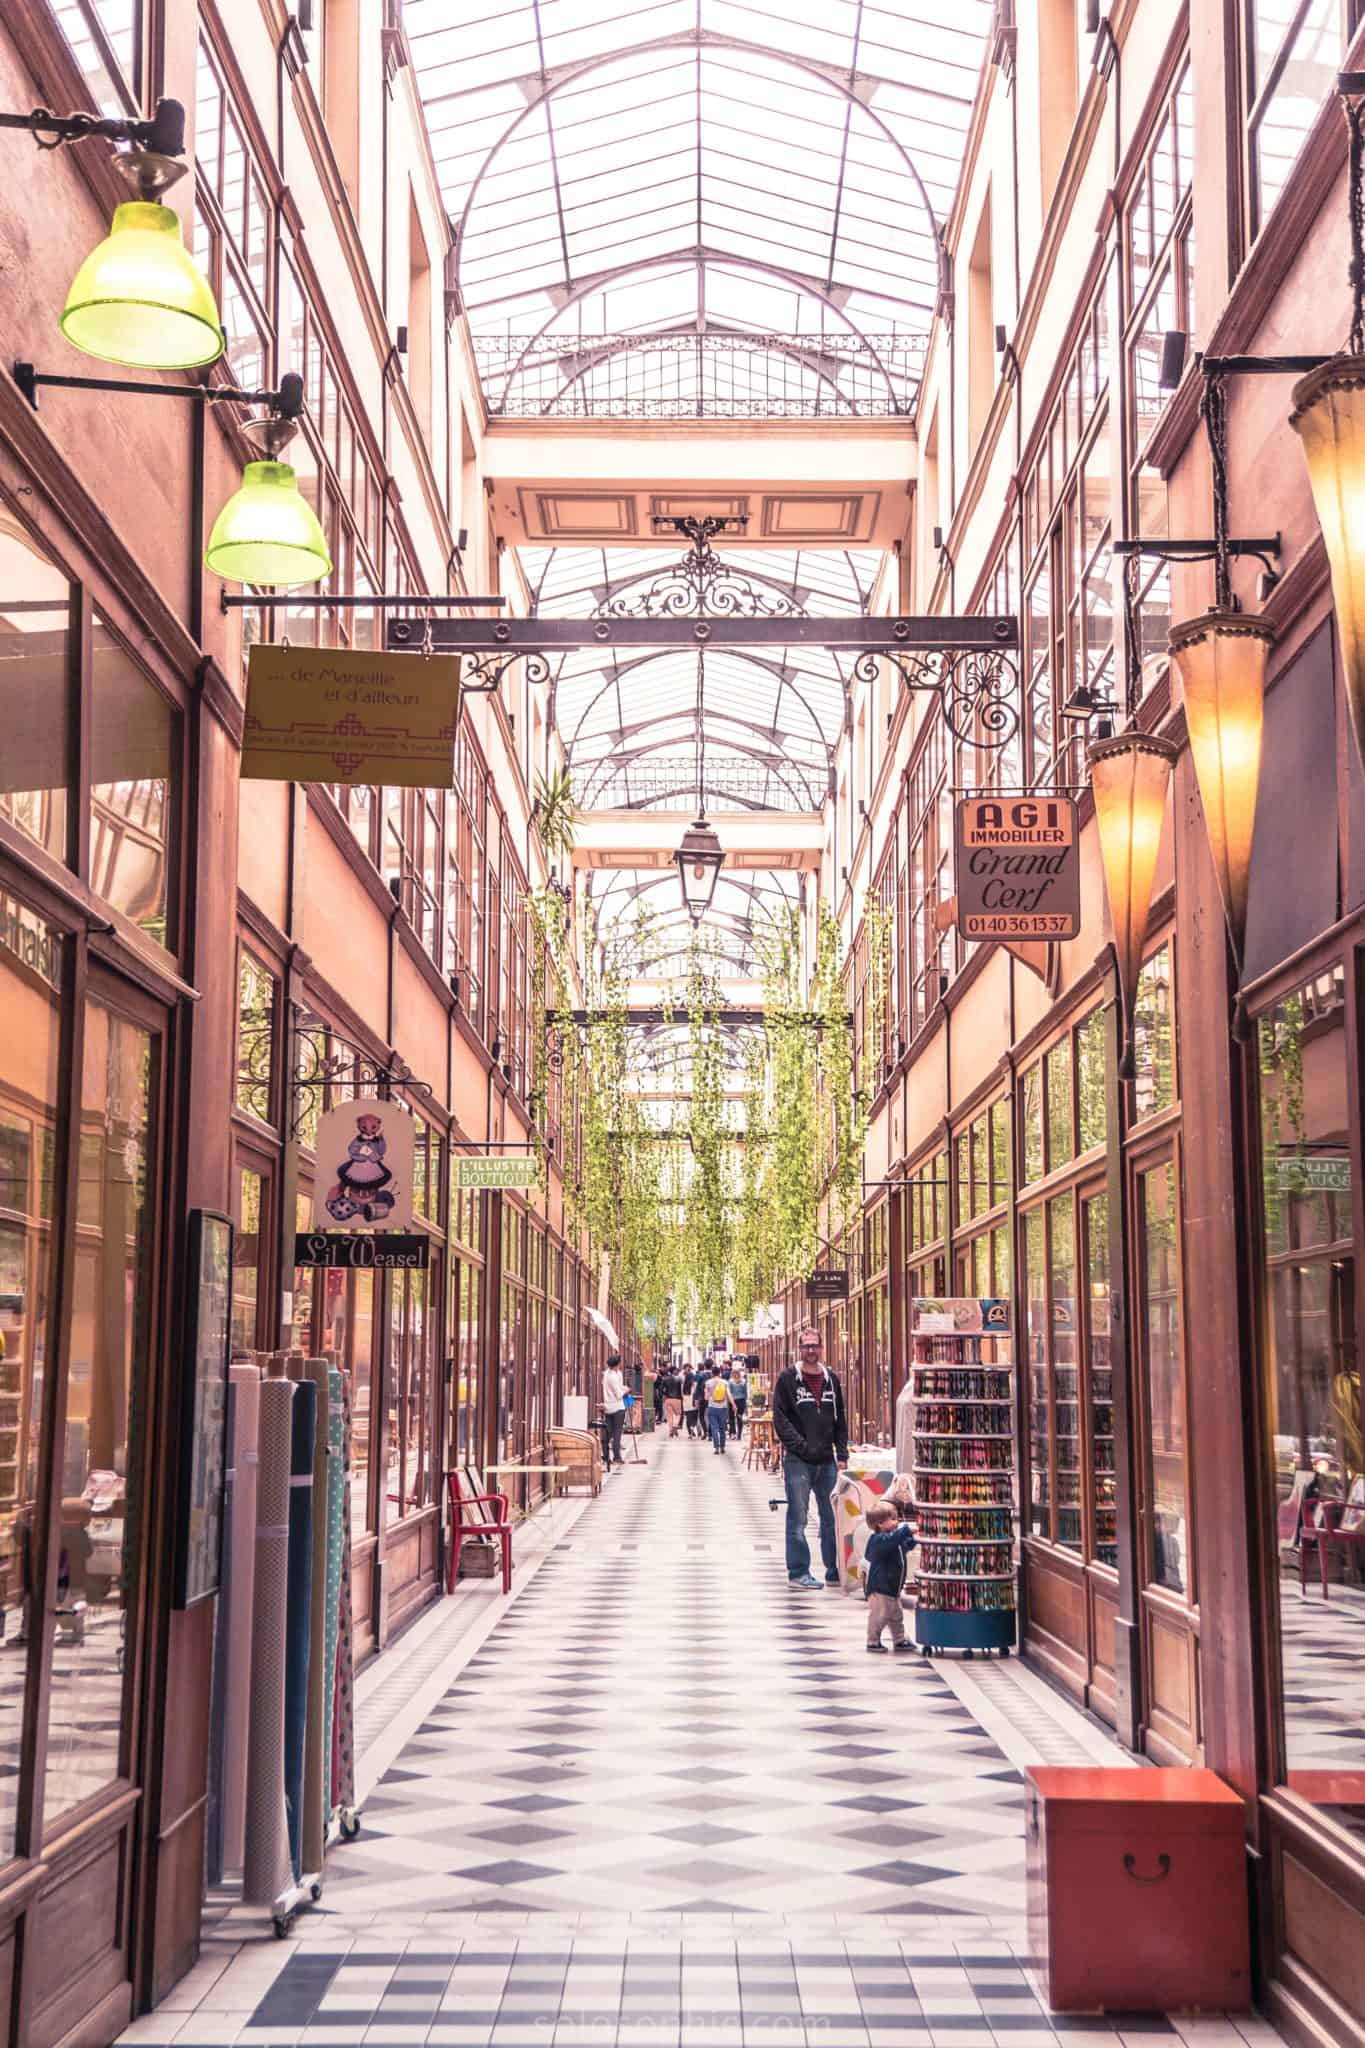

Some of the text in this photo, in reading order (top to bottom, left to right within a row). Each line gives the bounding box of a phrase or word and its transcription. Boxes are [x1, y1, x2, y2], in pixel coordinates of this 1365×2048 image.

[290, 665, 313, 682] de
[976, 803, 1058, 829] AGI
[970, 830, 1065, 843] IMMOBILIER
[968, 846, 1071, 875] Grand
[981, 878, 1055, 912] Cerf
[462, 1161, 534, 1172] L'ILLUSTRE
[300, 1234, 425, 1268] Lil Weasel
